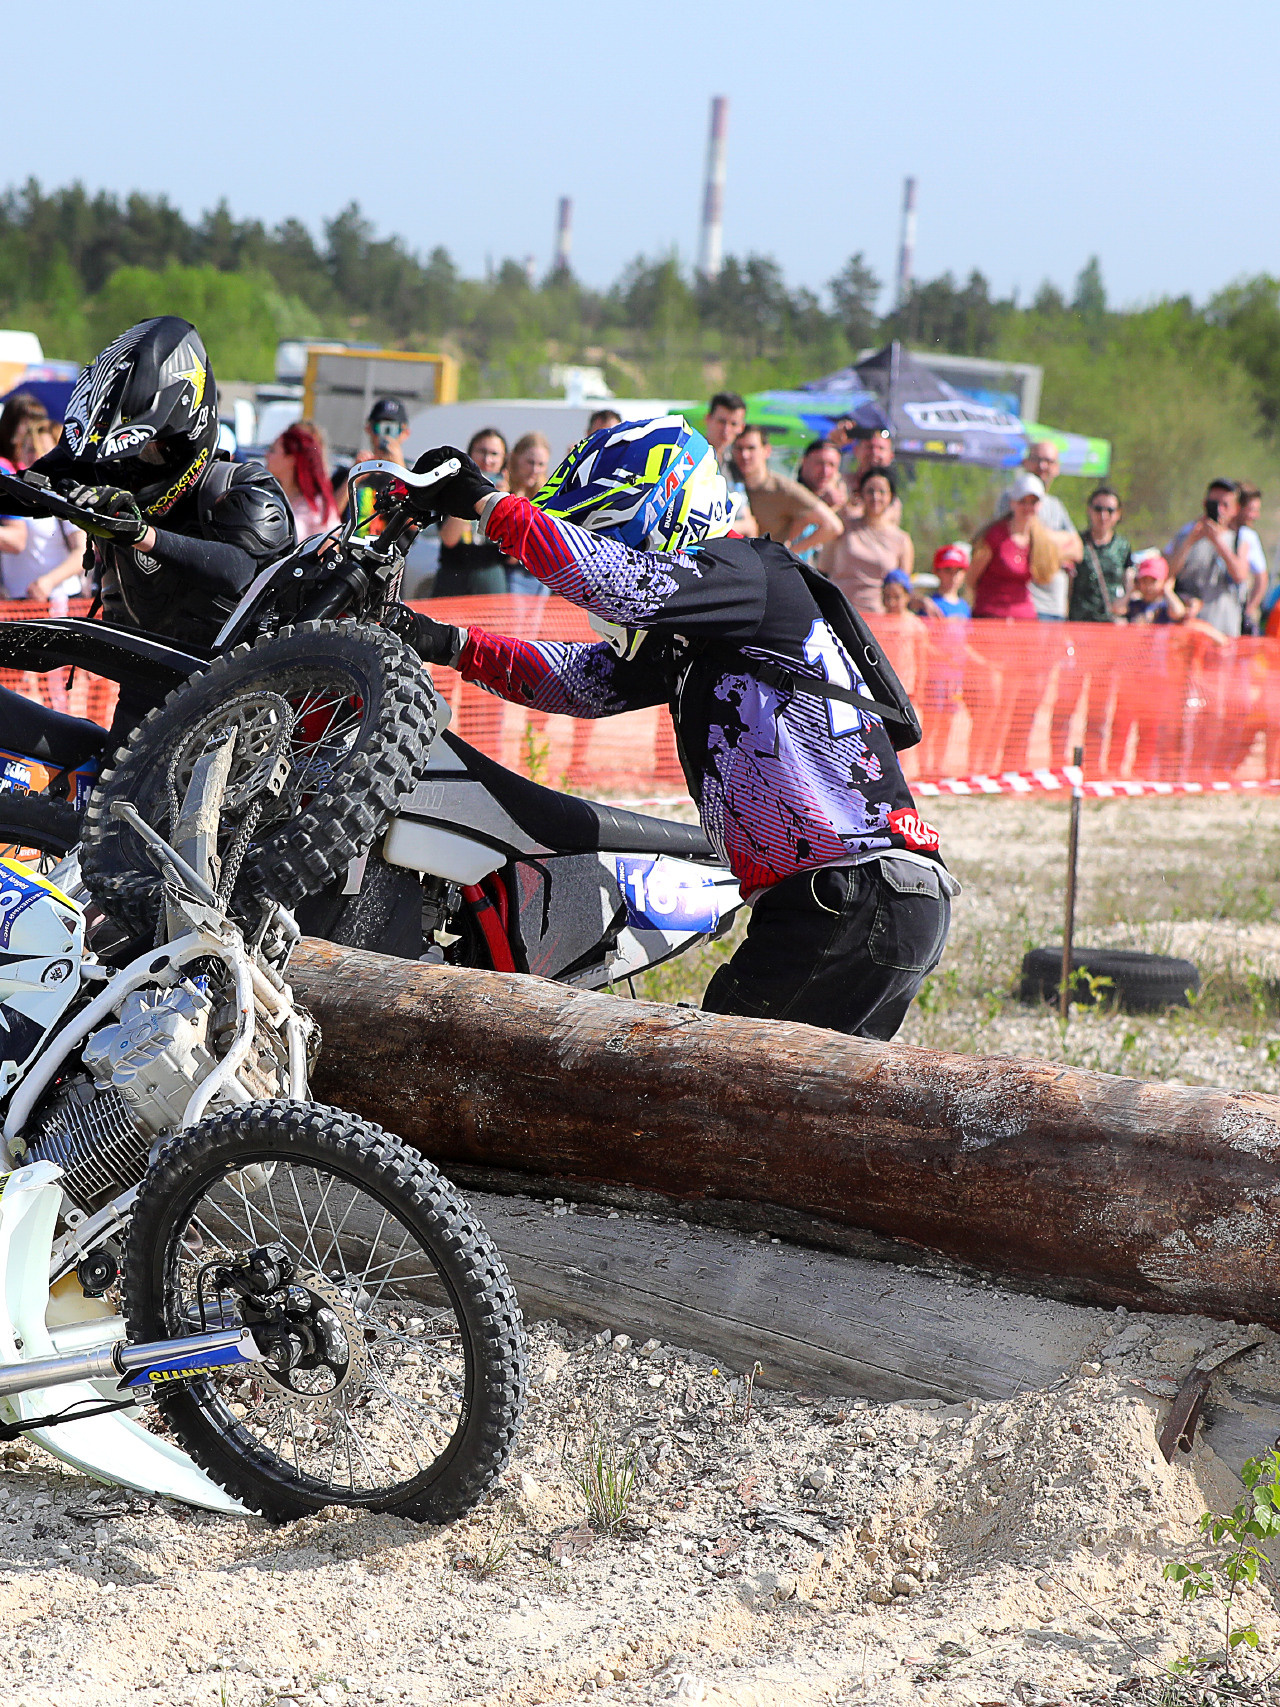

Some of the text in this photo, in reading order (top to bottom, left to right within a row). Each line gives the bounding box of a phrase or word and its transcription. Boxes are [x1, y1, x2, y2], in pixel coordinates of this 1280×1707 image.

[65, 422, 81, 452] Airoh
[105, 429, 150, 456] Airoh
[4, 761, 31, 784] KTM
[148, 1363, 235, 1384] ANTIS
